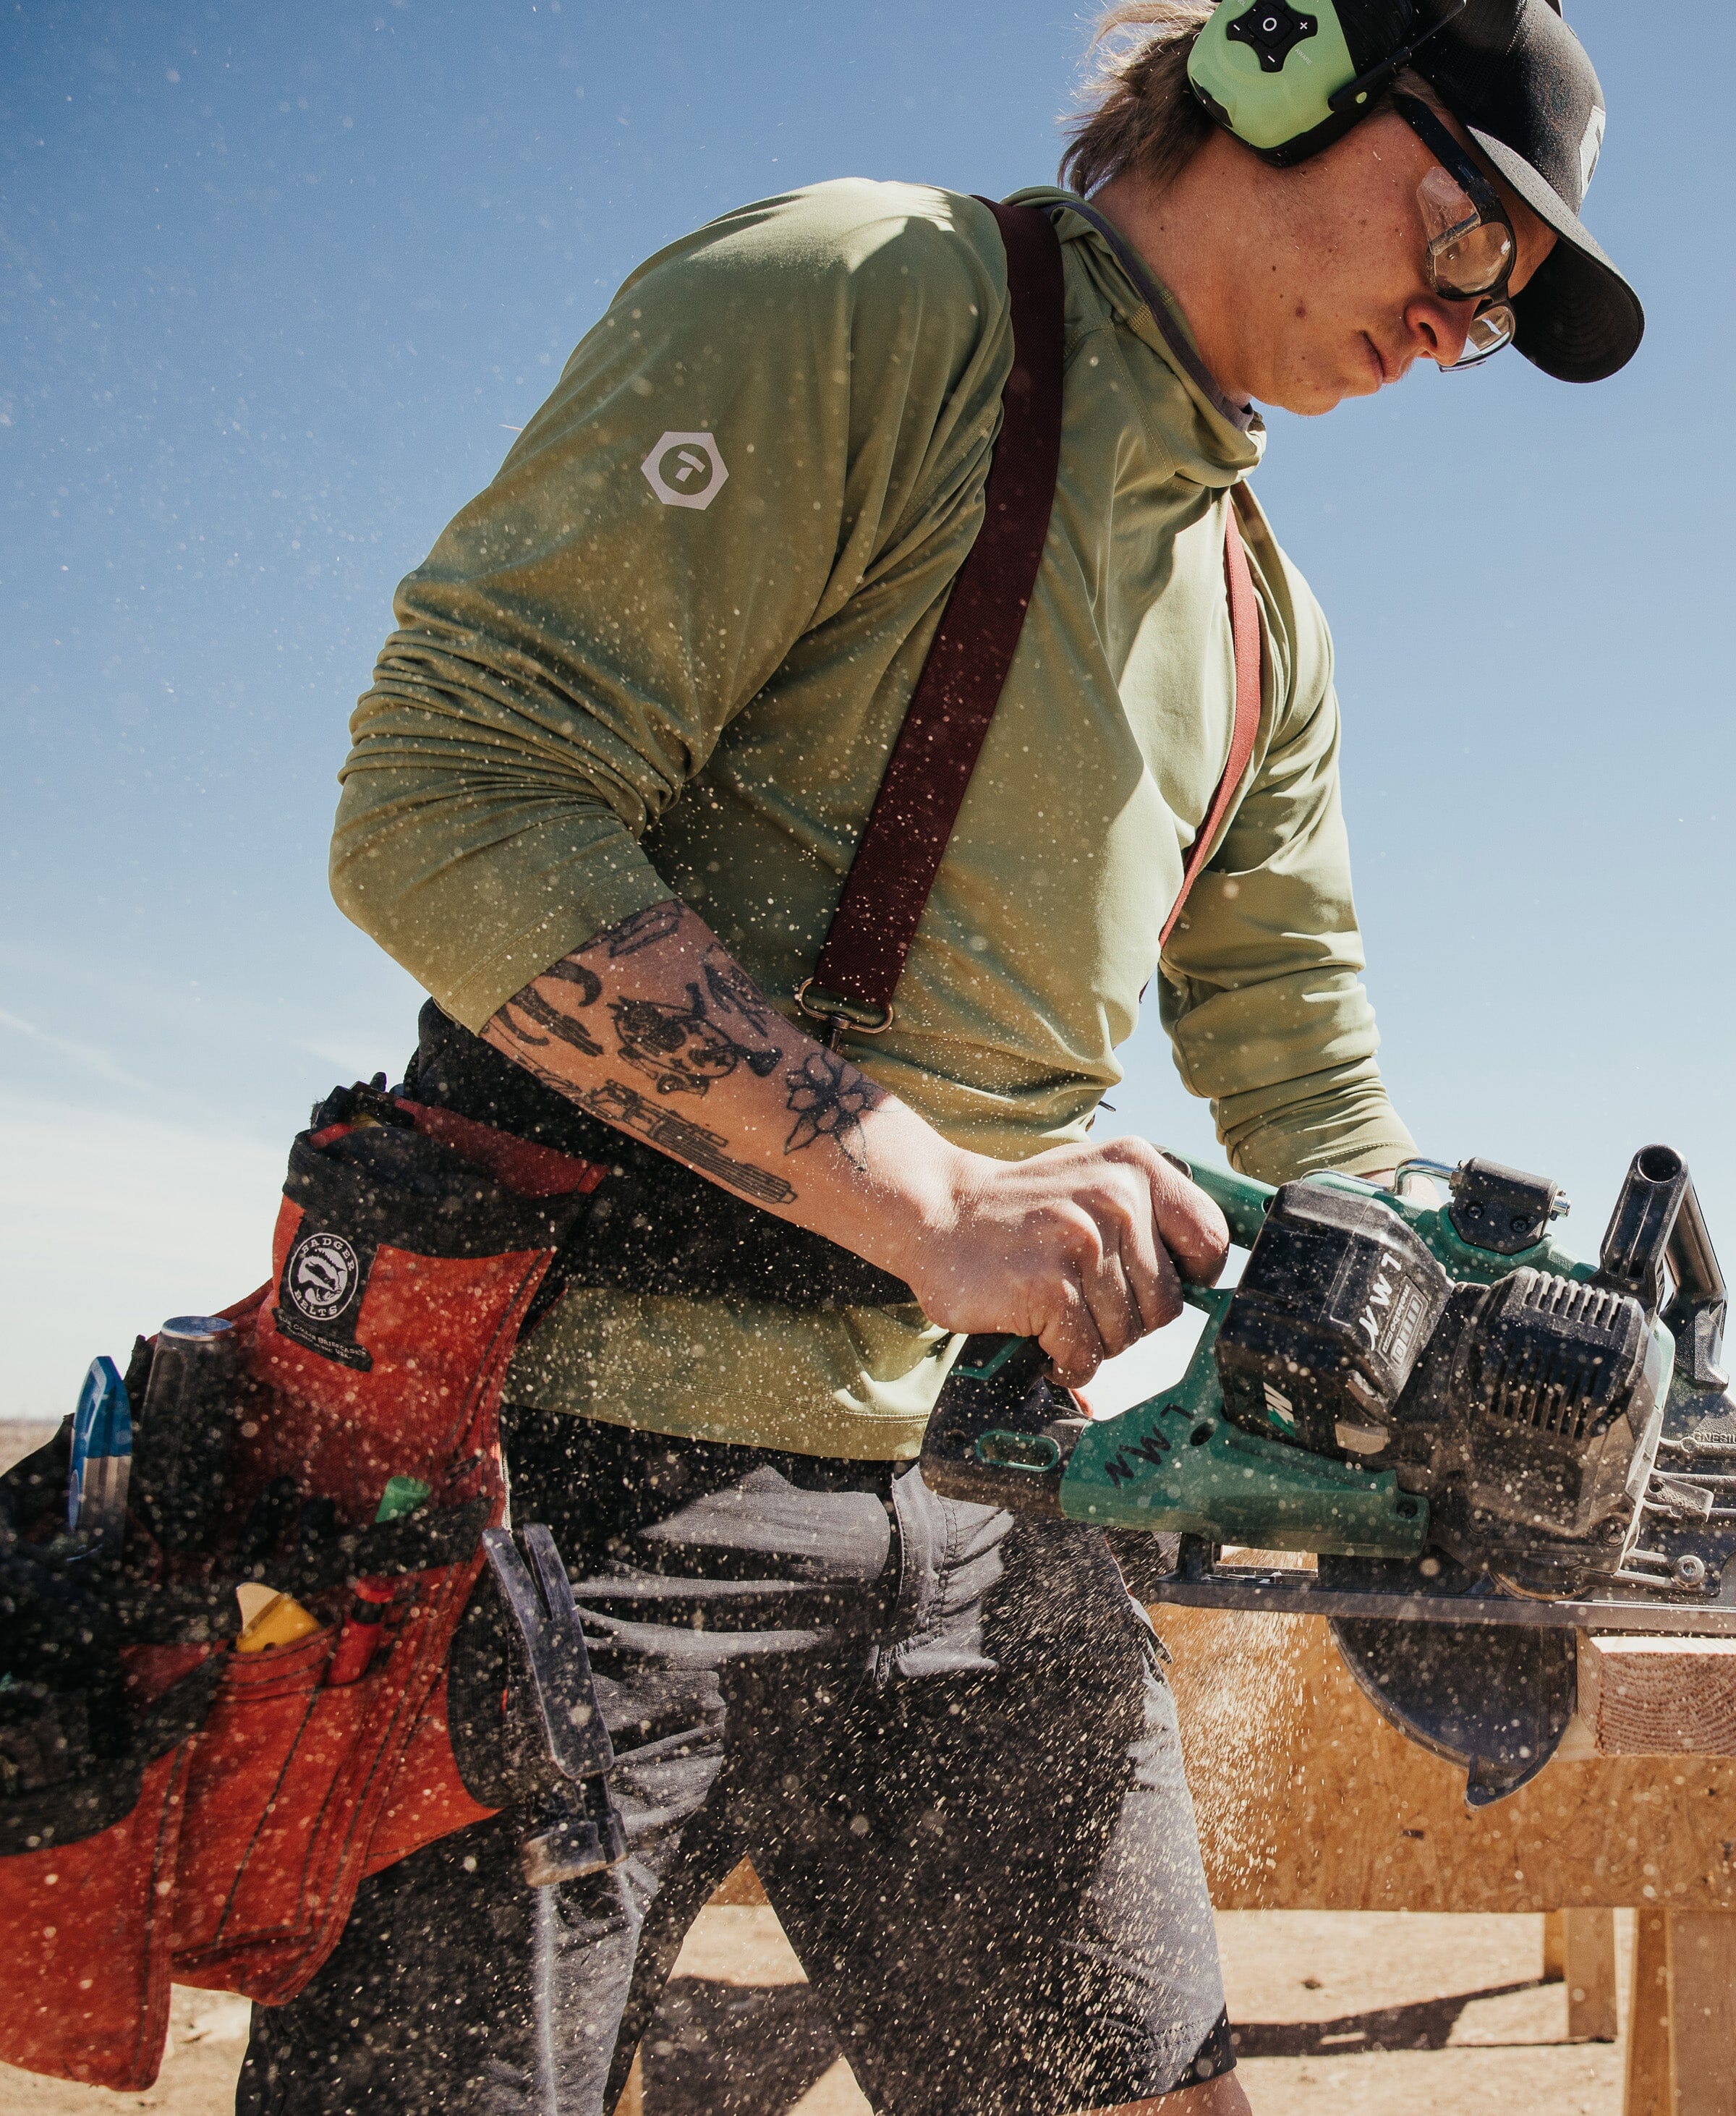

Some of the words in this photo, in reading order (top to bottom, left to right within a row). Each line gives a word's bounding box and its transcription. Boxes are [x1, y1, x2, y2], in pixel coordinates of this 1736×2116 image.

[1295, 48, 1312, 66] AWARE
[302, 1238, 355, 1272] BADGER
[294, 1288, 338, 1317] BELTS
